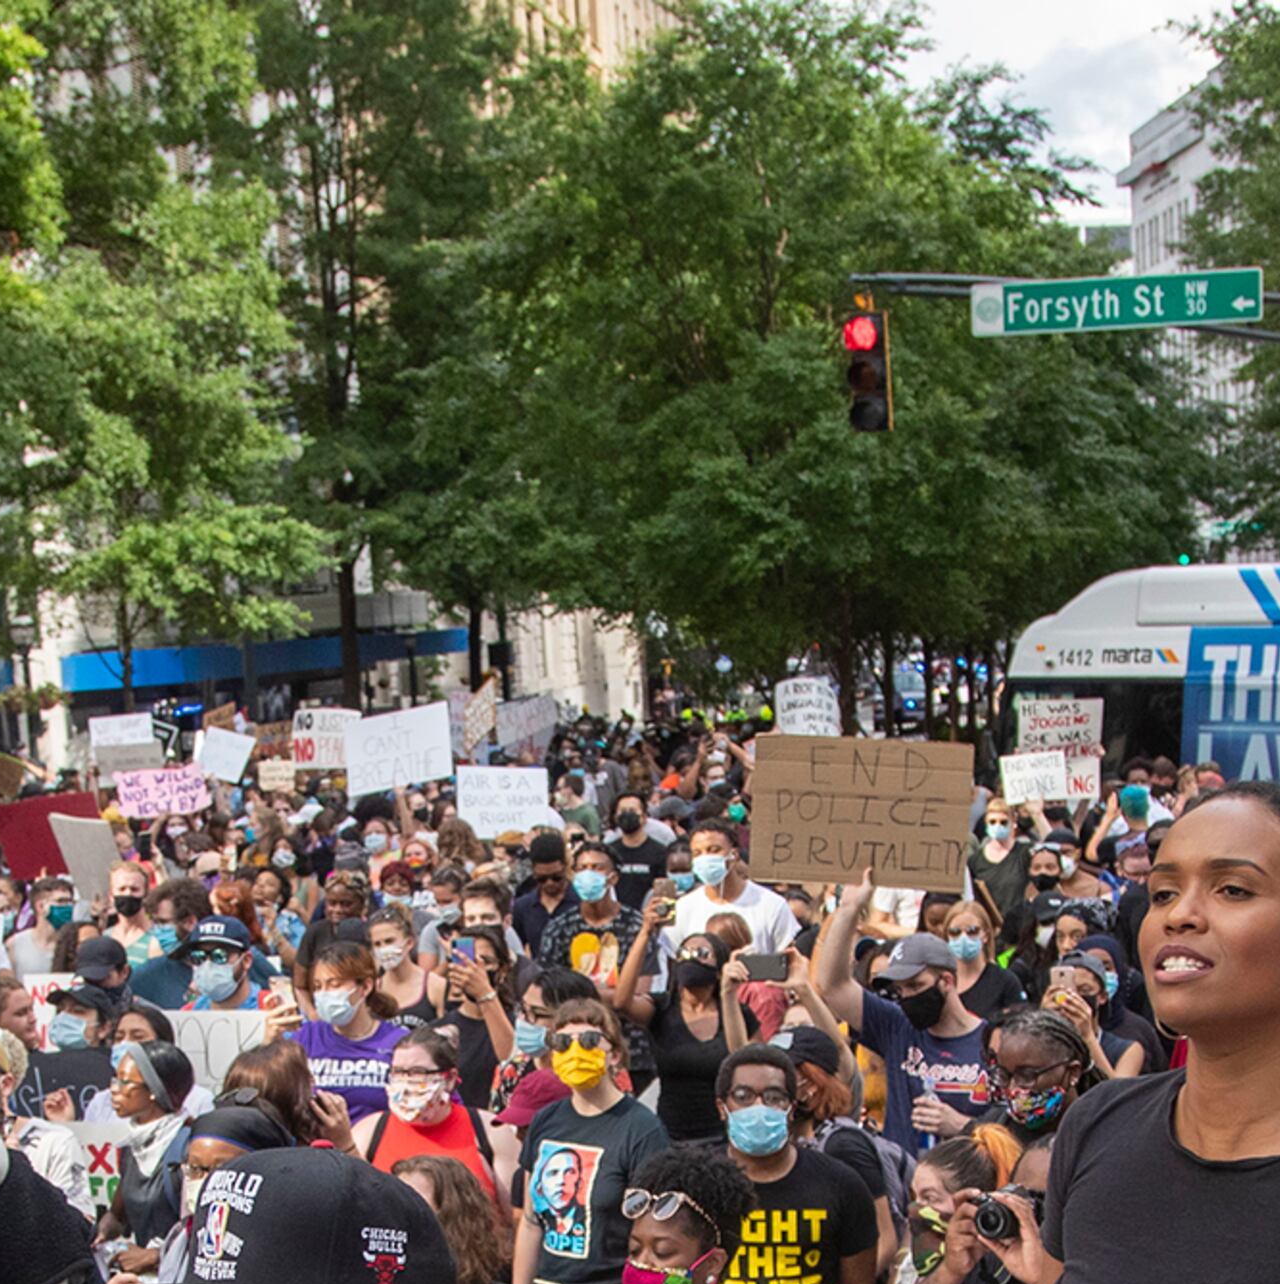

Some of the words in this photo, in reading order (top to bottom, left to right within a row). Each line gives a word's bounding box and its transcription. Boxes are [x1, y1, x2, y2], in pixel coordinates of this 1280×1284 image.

[1185, 281, 1208, 297] NW
[1007, 289, 1119, 329] Forsyth
[1133, 284, 1165, 317] St
[1186, 299, 1207, 315] 30
[1057, 650, 1094, 667] 1412
[1101, 648, 1153, 664] marta
[1021, 703, 1037, 717] HE
[1047, 702, 1082, 715] WAS
[294, 711, 315, 731] NO
[390, 715, 403, 730] I
[1027, 713, 1090, 731] JOGGING
[1023, 733, 1048, 748] SHE
[1057, 730, 1092, 743] WAS
[293, 736, 316, 764] NO
[350, 748, 436, 791] BREATHE
[809, 745, 930, 793] END
[122, 774, 142, 789] WE
[153, 769, 193, 785] WILL
[463, 774, 492, 790] AIR
[497, 774, 512, 790] IS
[516, 775, 530, 789] A
[1009, 775, 1057, 796] SILENCE
[122, 787, 149, 803] NOT
[479, 810, 526, 825] RIGHT
[776, 788, 947, 828] POLICE
[771, 832, 968, 877] BRUTALITY
[198, 922, 225, 936] YETI
[312, 1073, 390, 1089] ASKETBALL
[206, 1169, 264, 1198] WORLD
[361, 1226, 408, 1243] CHICAGO
[741, 1209, 827, 1244] GHT
[368, 1240, 405, 1255] BULLS
[544, 1231, 586, 1254] OPE
[728, 1246, 803, 1279] THE
